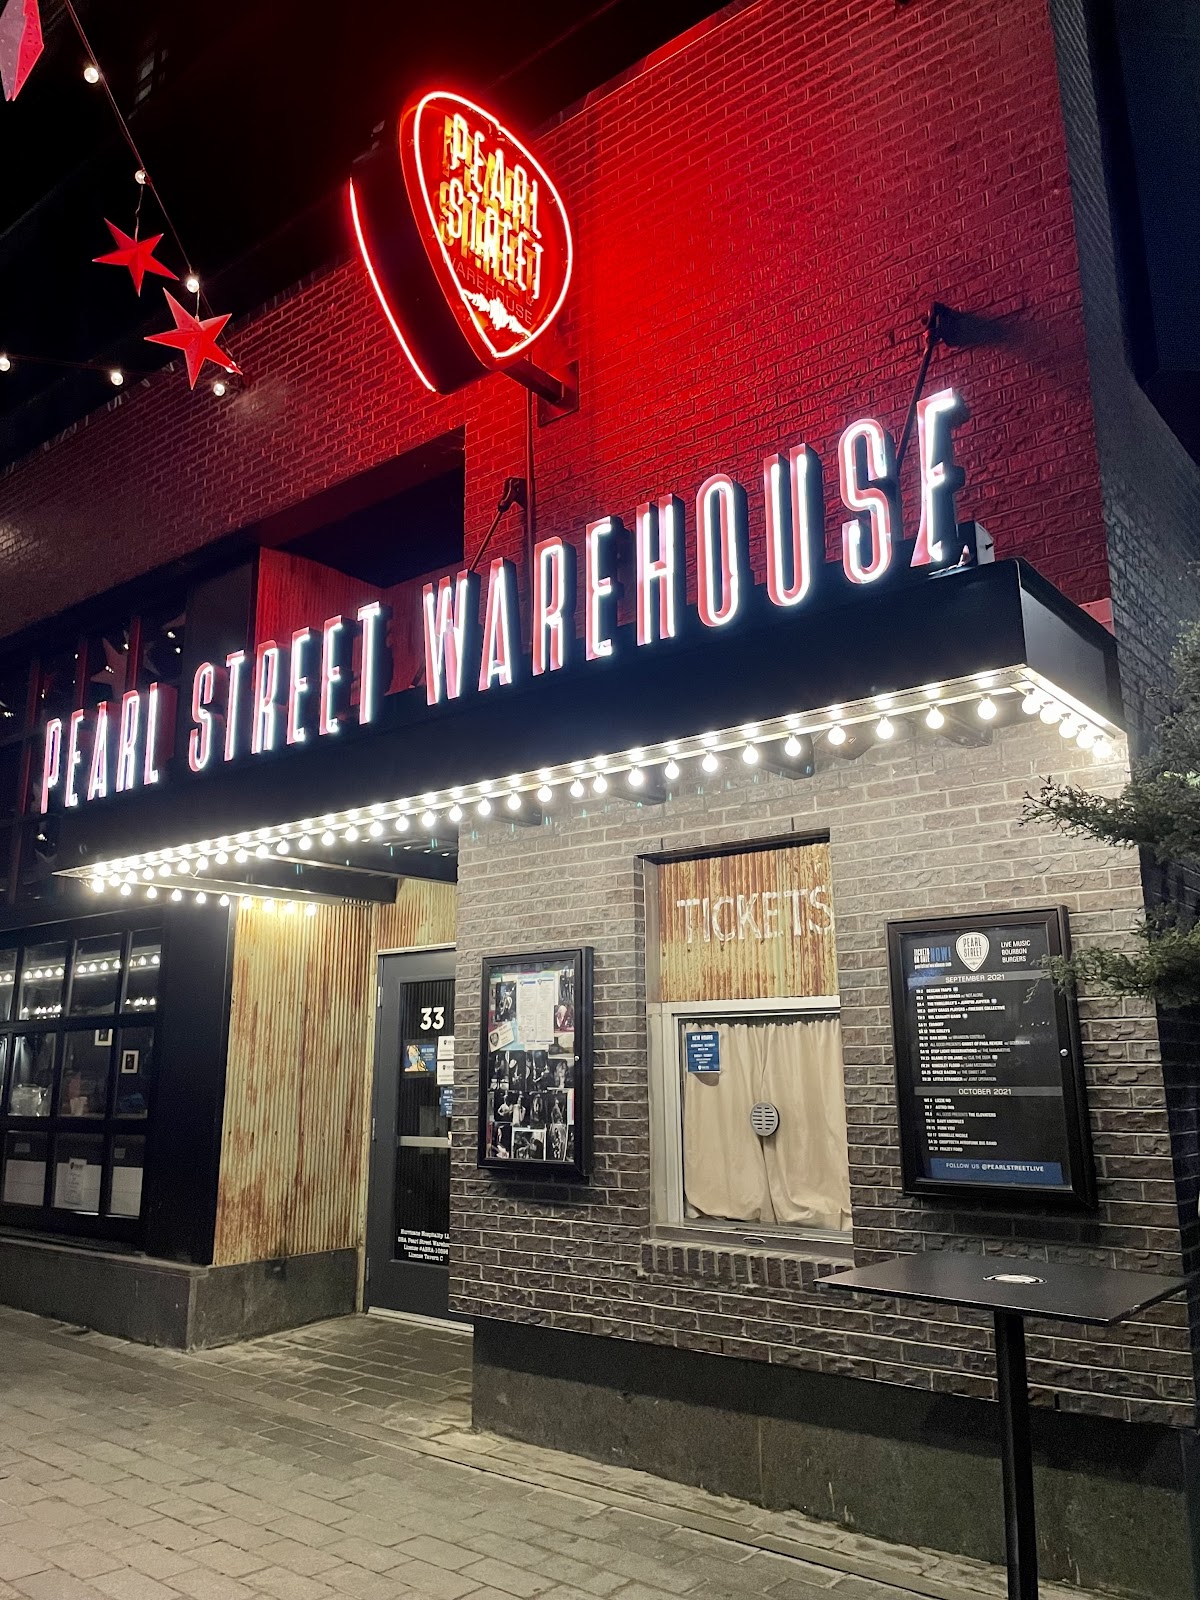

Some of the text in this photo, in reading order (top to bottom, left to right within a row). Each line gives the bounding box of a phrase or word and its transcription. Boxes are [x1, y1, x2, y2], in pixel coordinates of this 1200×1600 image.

[444, 114, 541, 238] PEARL
[440, 178, 543, 302] STREET
[443, 252, 533, 326] WAREHOUSE
[40, 387, 957, 814] PEARL STREET WAREHOUSE
[677, 885, 834, 944] TICKETS
[930, 946, 951, 961] NOW!
[963, 938, 982, 947] PEARL
[964, 947, 982, 957] STREET
[946, 975, 984, 983] SEPTEMBER
[420, 1006, 445, 1030] 33
